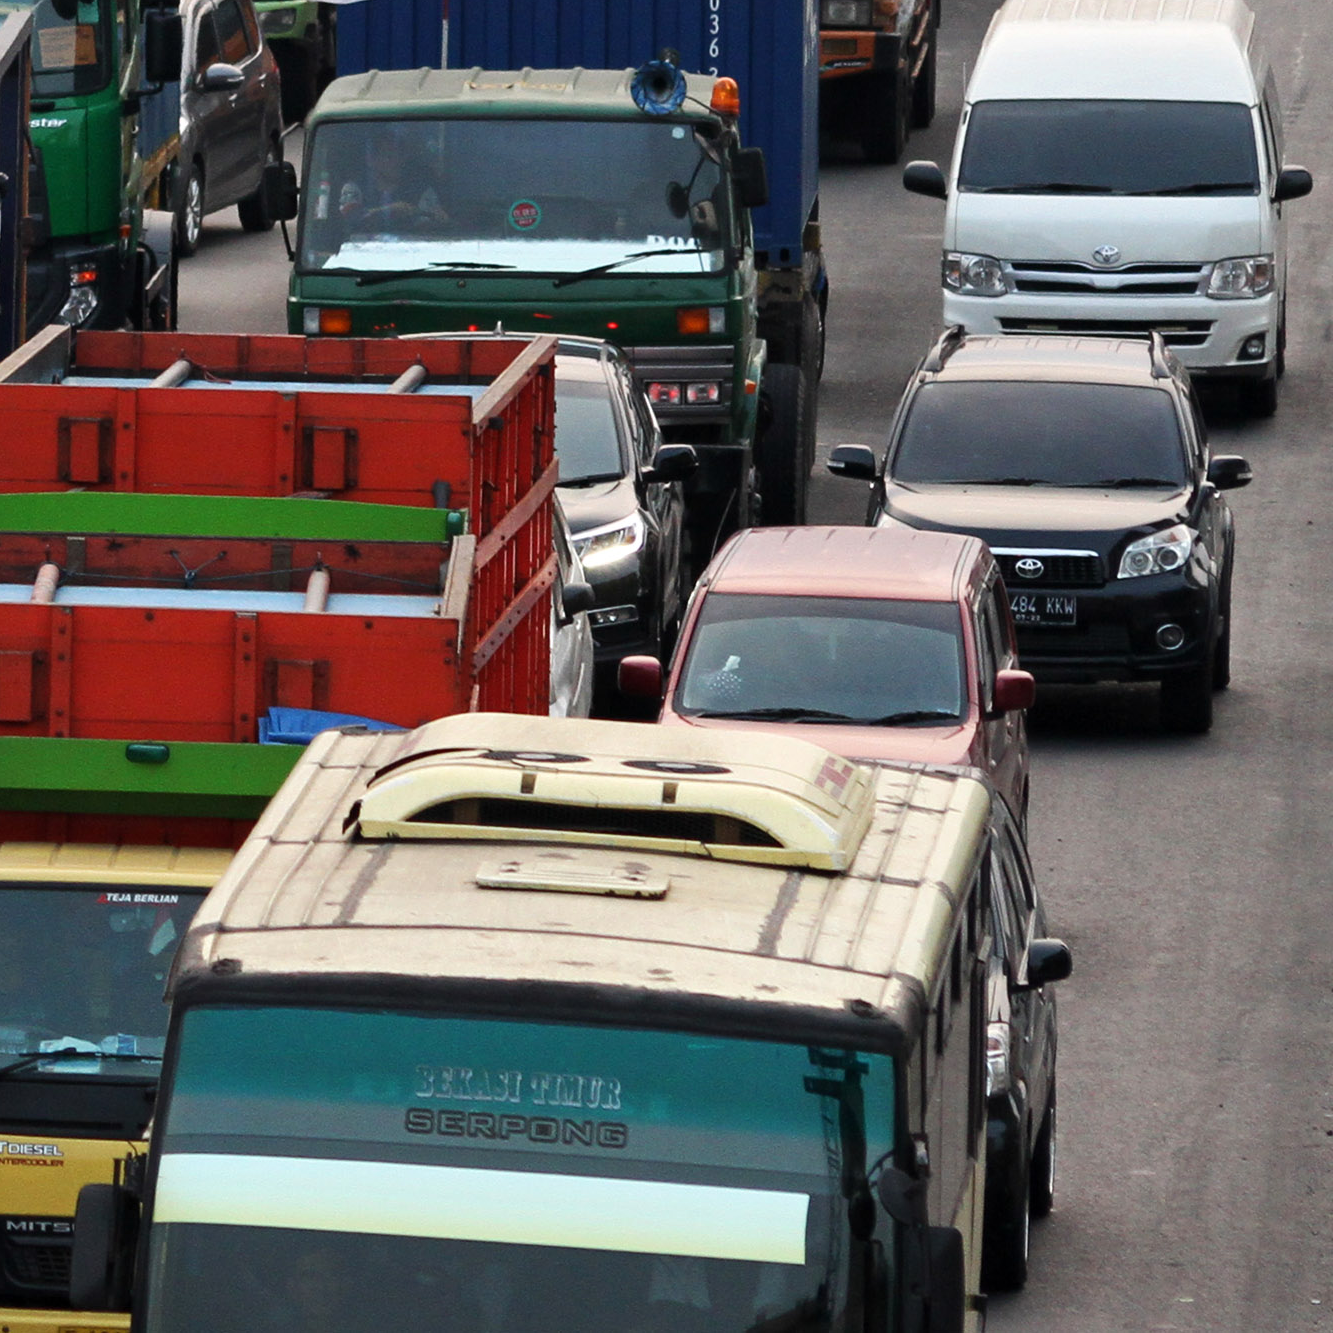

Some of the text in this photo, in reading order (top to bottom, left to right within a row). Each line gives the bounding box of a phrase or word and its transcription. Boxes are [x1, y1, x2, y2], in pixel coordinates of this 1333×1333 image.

[29, 117, 69, 129] ster
[1046, 596, 1074, 614] KKW
[105, 892, 179, 905] TEJA BERLIAN
[531, 1073, 622, 1110] TIMUR
[405, 1107, 629, 1149] SERPONG
